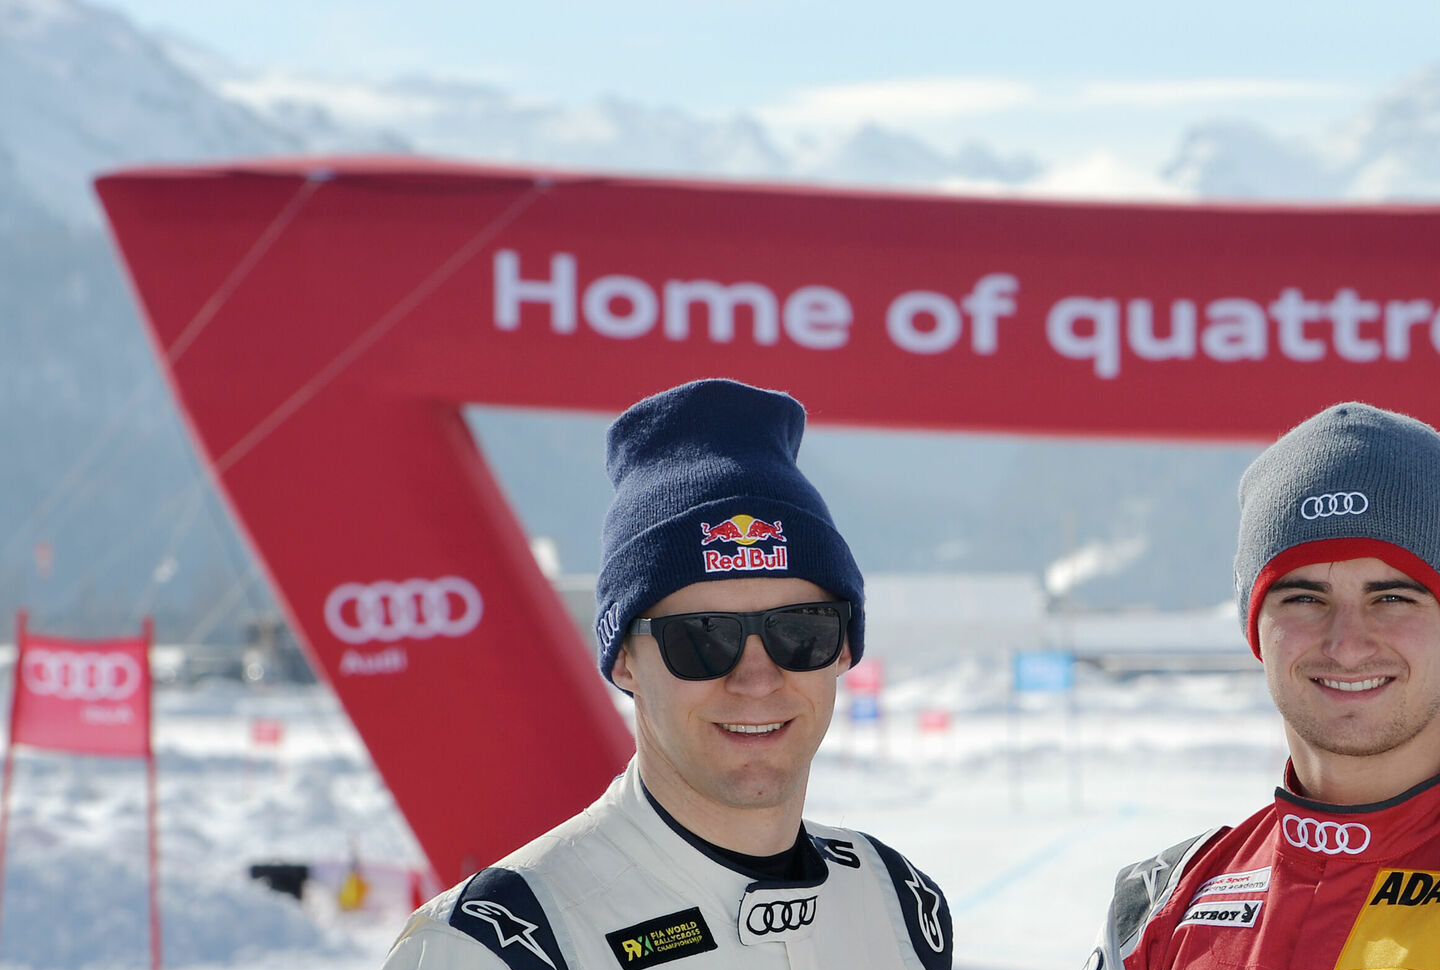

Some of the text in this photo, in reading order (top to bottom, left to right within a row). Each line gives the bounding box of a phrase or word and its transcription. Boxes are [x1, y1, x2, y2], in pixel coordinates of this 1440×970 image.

[493, 247, 853, 350] Home
[885, 272, 1020, 356] of
[703, 546, 787, 572] Red Bull
[650, 921, 697, 940] FIA WORLD
[654, 928, 701, 946] RALLYCROSS
